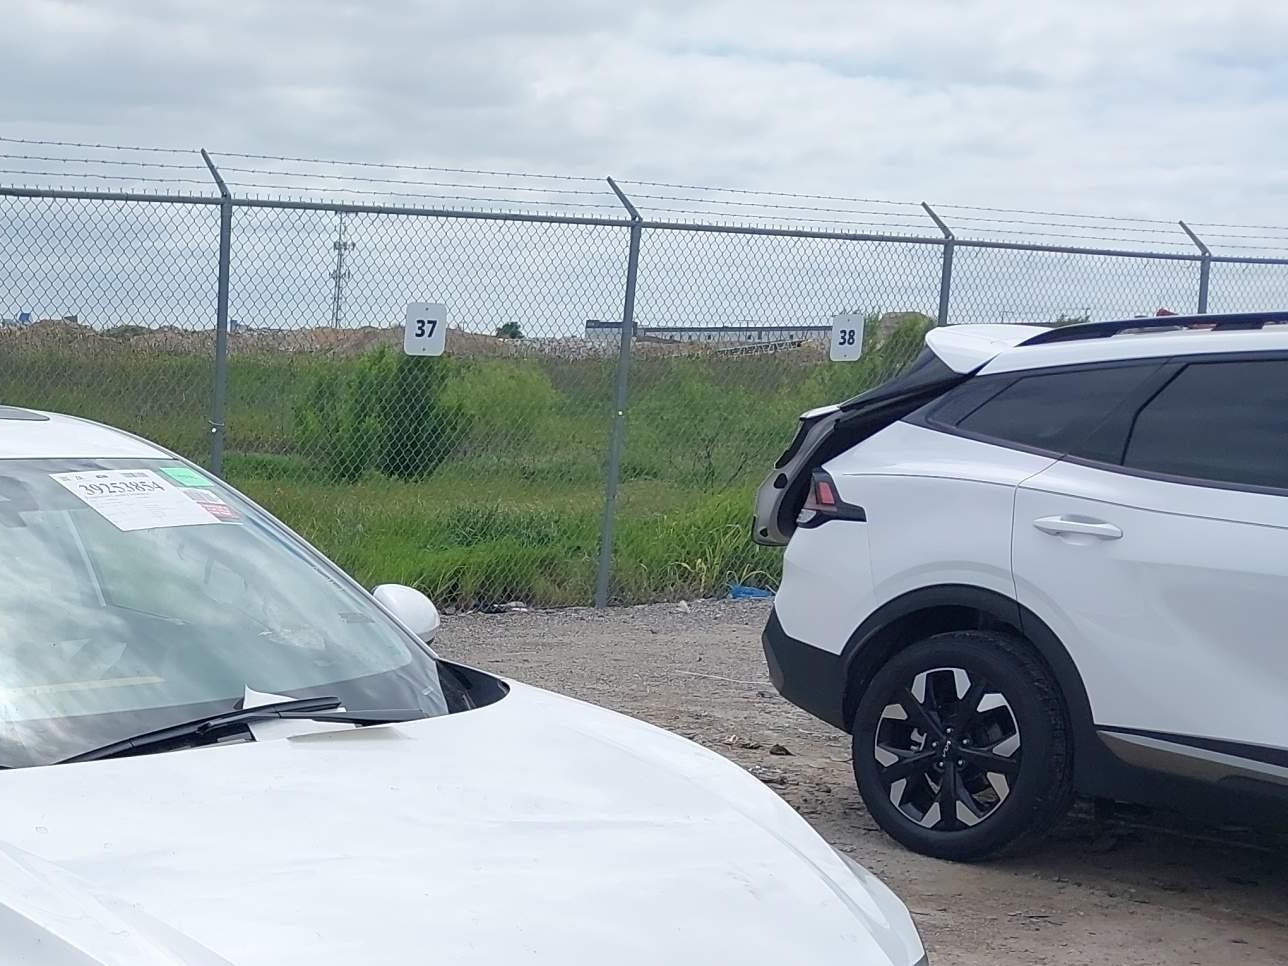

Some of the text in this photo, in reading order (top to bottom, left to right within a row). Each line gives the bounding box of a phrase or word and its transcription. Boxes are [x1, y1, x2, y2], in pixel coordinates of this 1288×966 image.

[415, 319, 438, 338] 37
[838, 329, 856, 346] 38
[78, 481, 166, 496] 39253854
